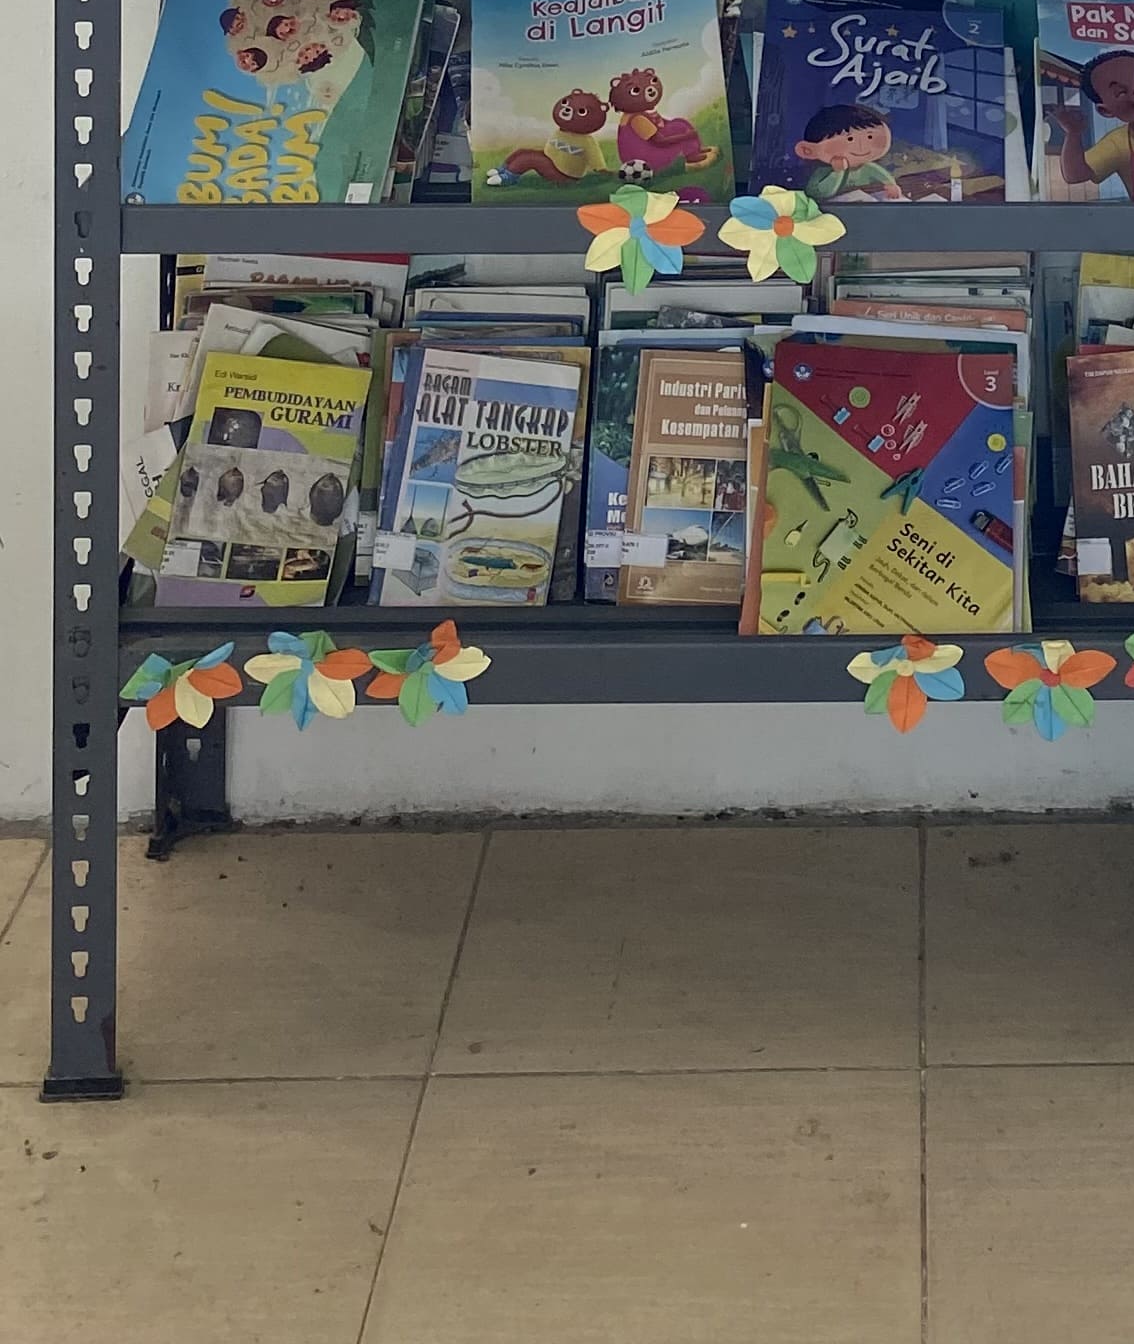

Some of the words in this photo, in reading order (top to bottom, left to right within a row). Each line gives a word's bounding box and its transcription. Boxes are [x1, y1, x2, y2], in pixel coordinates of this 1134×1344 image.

[1070, 4, 1115, 24] Pak
[526, 19, 557, 42] di
[806, 14, 936, 67] Surat
[968, 22, 981, 35] 2
[1076, 25, 1108, 39] dan
[831, 54, 948, 98] Ajaib
[423, 372, 472, 397] RAGAM
[660, 379, 713, 399] Industri
[984, 375, 998, 392] 3
[224, 385, 357, 412] PEMBUDIDAYAAN
[269, 407, 354, 430] GURAMI
[416, 392, 470, 427] ALAT
[476, 400, 570, 438] TANGKAP
[466, 430, 563, 458] LOBSTER
[898, 521, 938, 553] Seni
[936, 547, 955, 570] di
[886, 537, 946, 585] Sekitar
[944, 580, 981, 617] Kita
